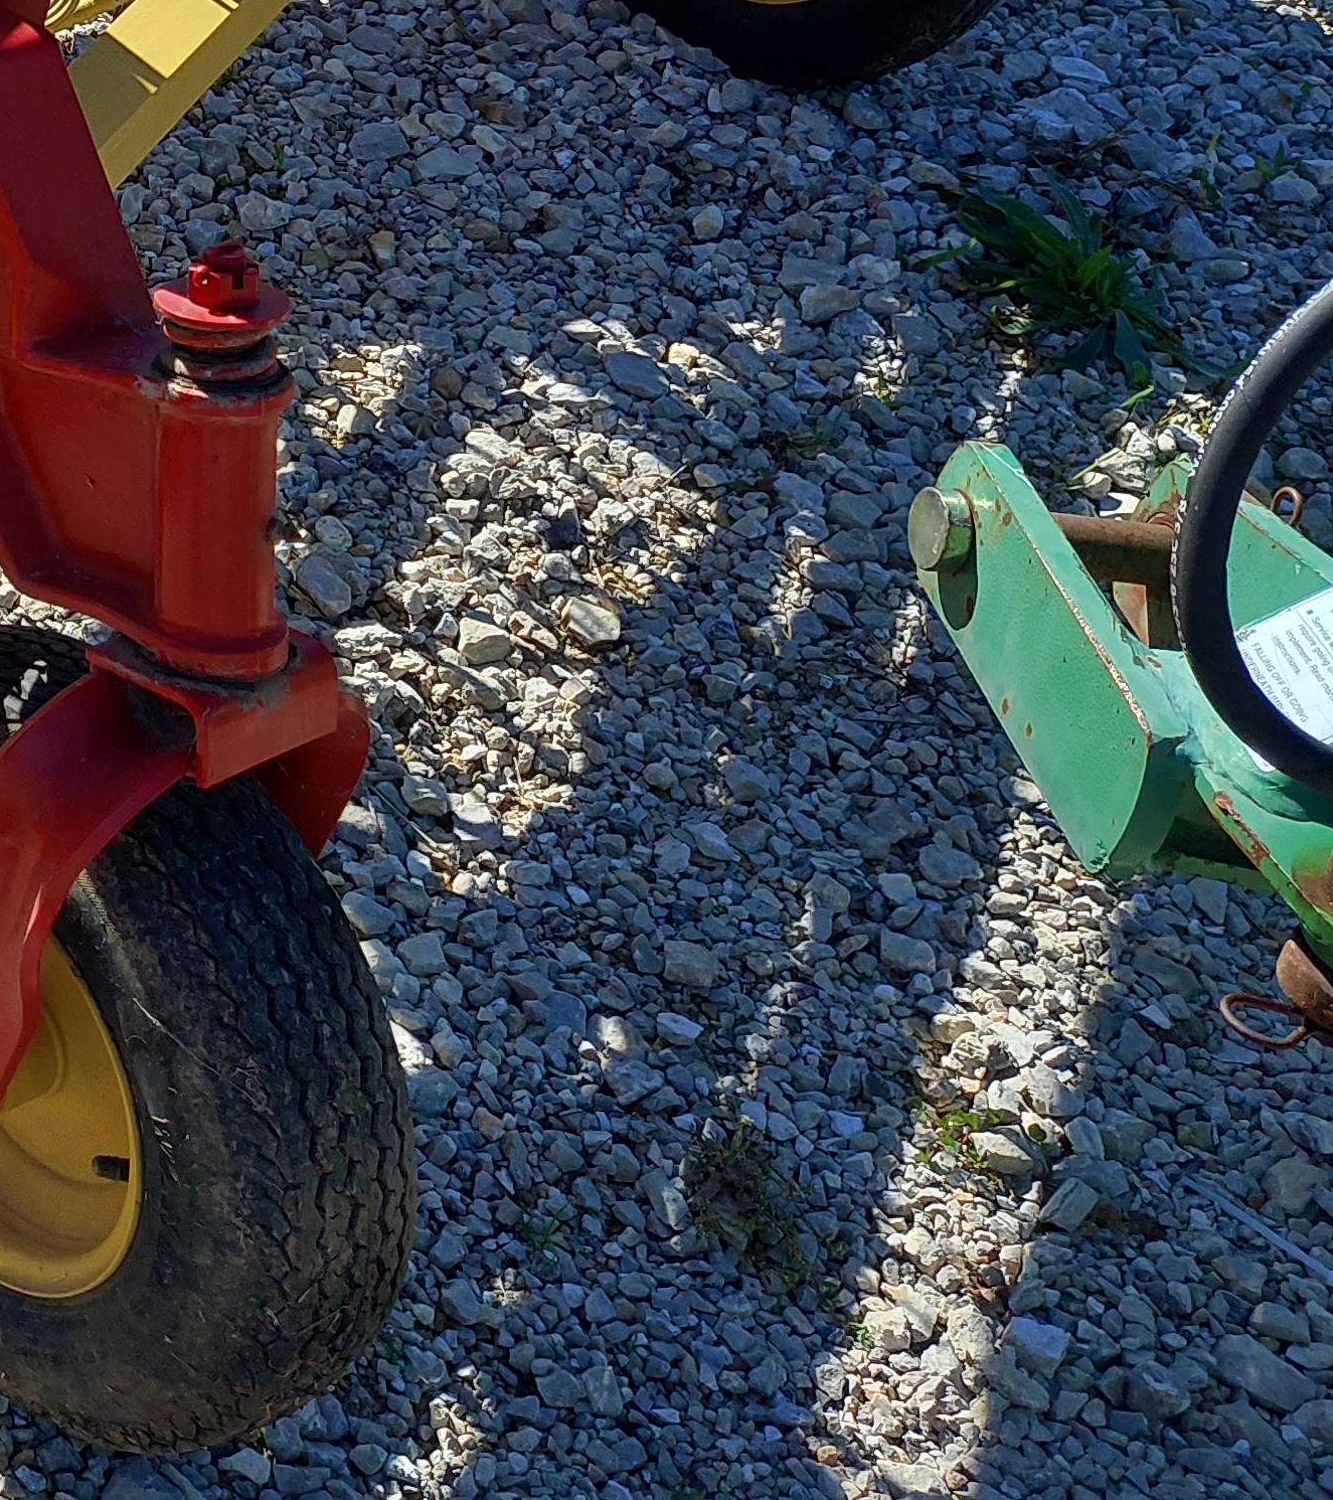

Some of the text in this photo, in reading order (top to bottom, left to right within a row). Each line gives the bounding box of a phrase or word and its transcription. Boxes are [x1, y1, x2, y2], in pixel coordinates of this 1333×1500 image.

[1297, 623, 1331, 667] require going
[1312, 616, 1332, 641] Service
[1252, 642, 1309, 723] FALLING OFF OR GOING
[1309, 663, 1327, 682] Read
